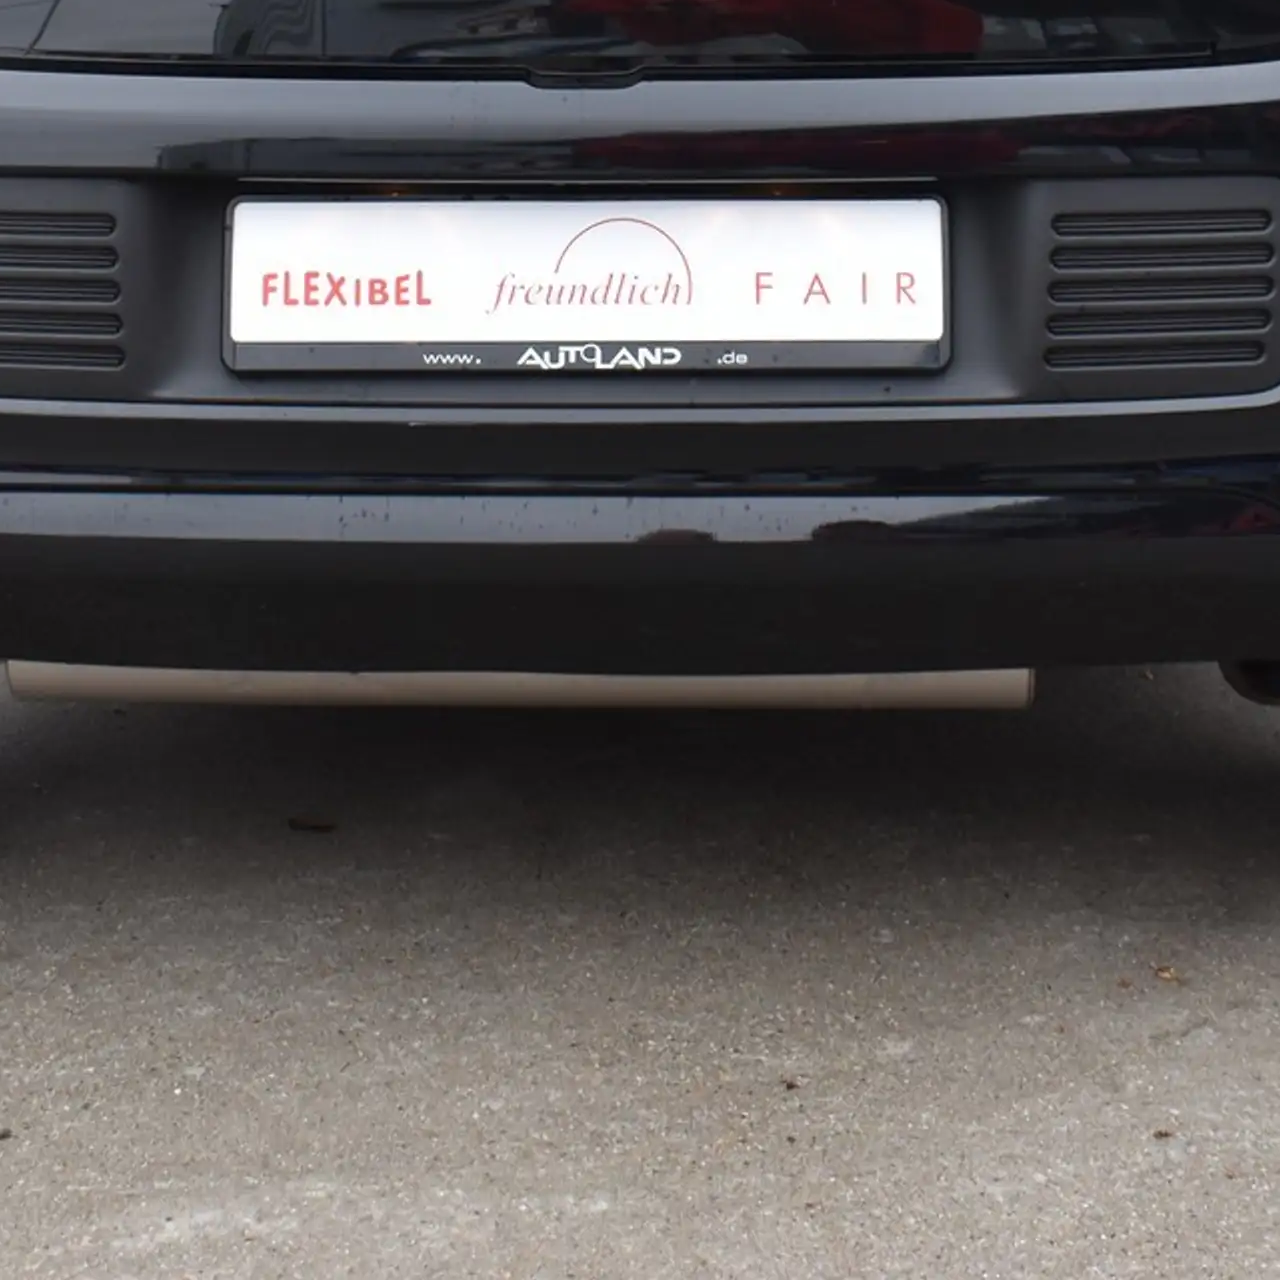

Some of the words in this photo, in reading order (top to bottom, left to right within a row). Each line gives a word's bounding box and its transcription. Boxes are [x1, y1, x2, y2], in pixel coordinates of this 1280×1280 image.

[261, 270, 433, 307] FLEXIBEL
[484, 271, 681, 315] freundlich
[422, 352, 482, 366] www.
[517, 344, 682, 371] AUTOLAND
[716, 351, 748, 365] .de
